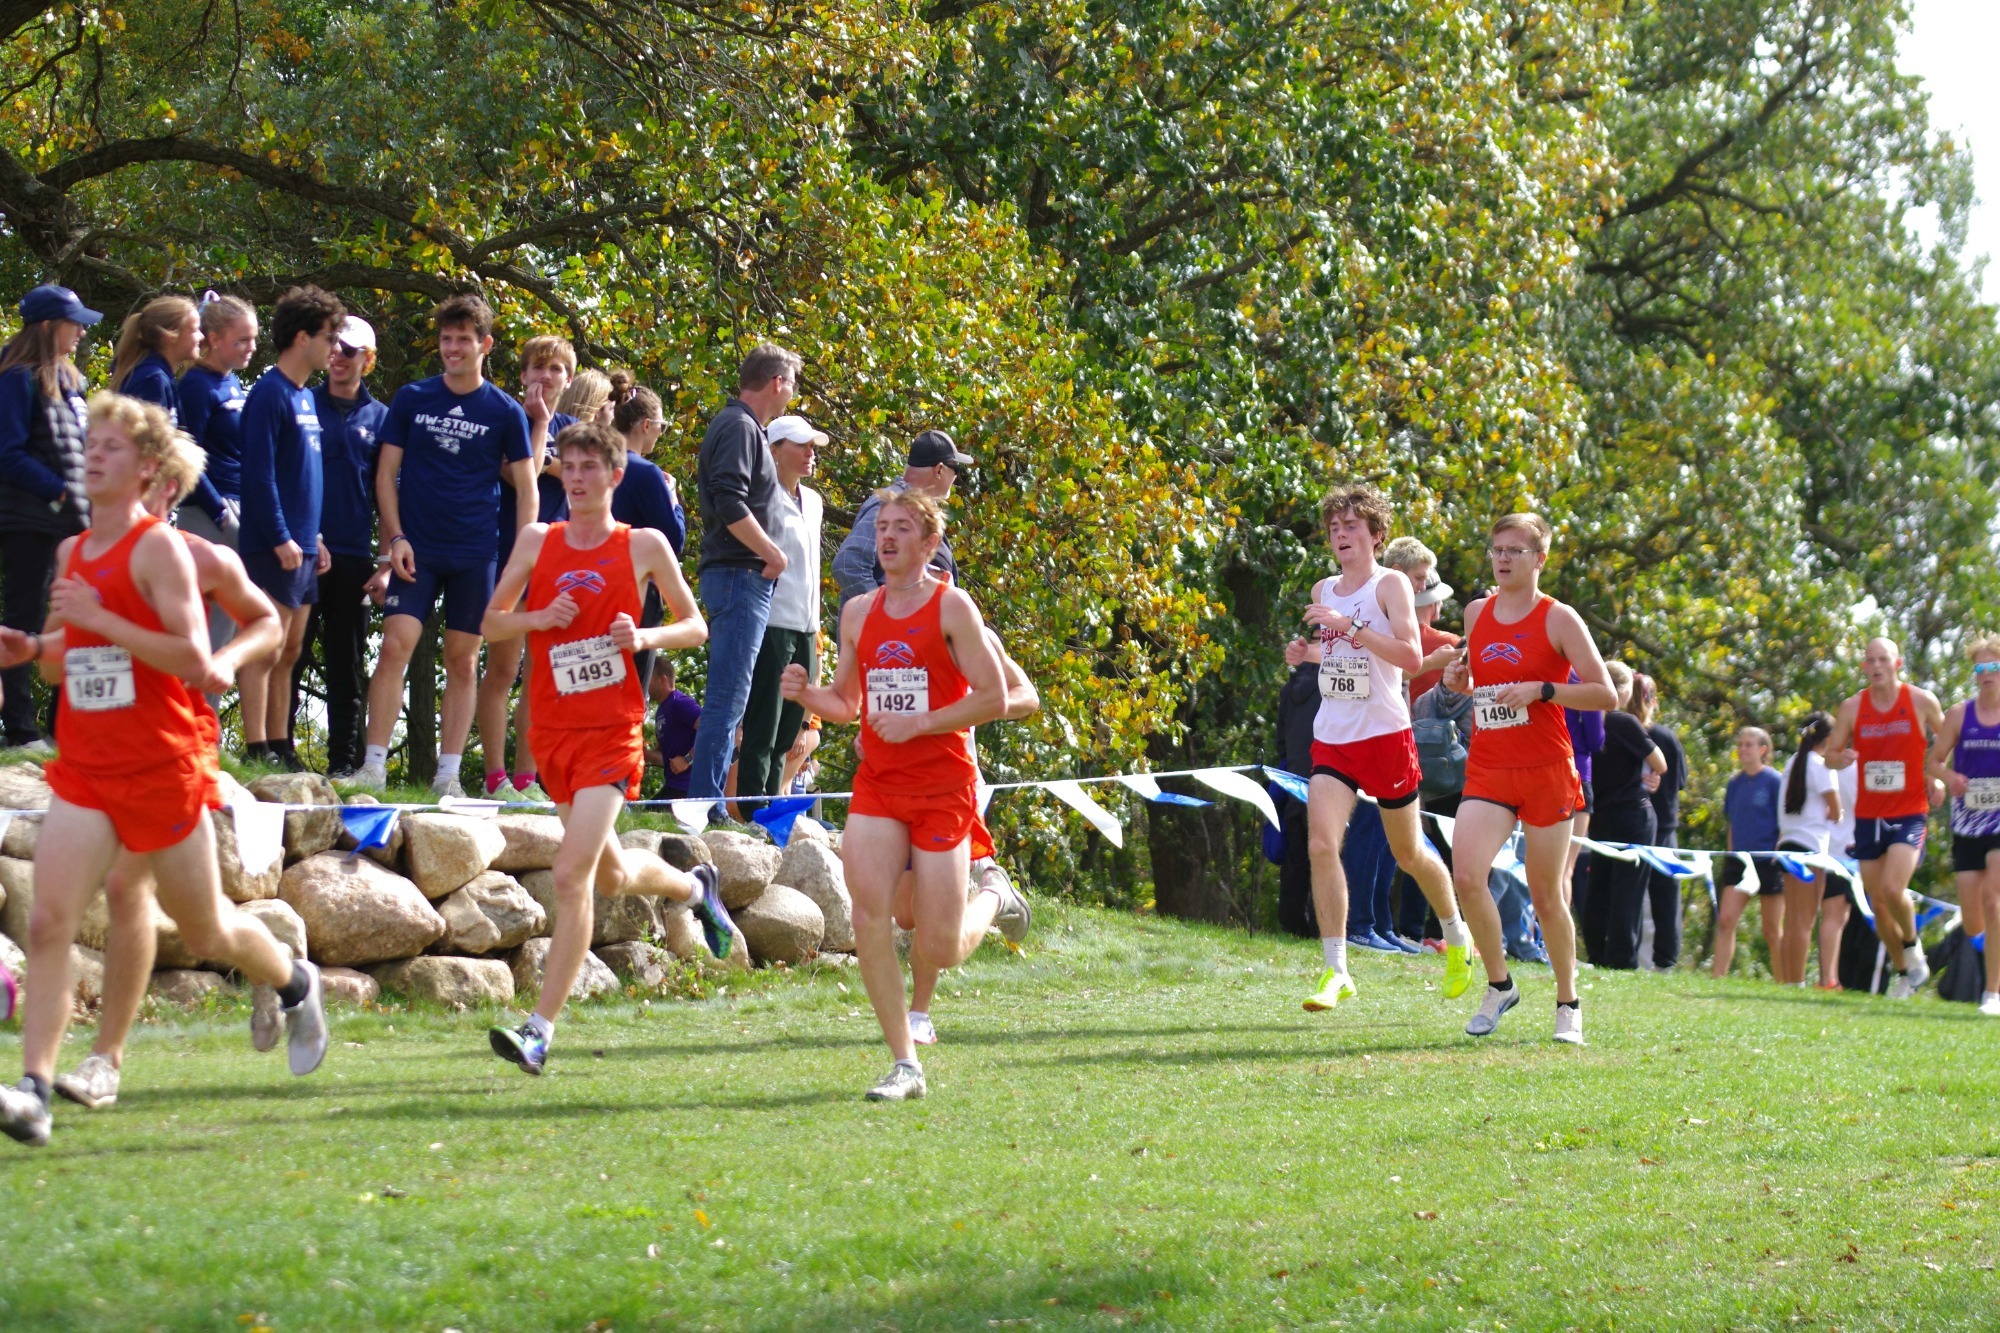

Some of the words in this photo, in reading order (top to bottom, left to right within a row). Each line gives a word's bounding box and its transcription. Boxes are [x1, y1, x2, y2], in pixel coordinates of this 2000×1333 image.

[415, 413, 490, 436] UW-STOUT
[427, 425, 448, 434] TRACK
[454, 429, 473, 439] FIELD
[594, 639, 616, 651] COW
[566, 660, 613, 685] 1493
[901, 673, 926, 682] COWS
[75, 676, 118, 698] 1497
[1330, 677, 1355, 692] 768
[876, 693, 916, 712] 1492
[1481, 705, 1517, 722] 1490
[1874, 775, 1895, 786] 667
